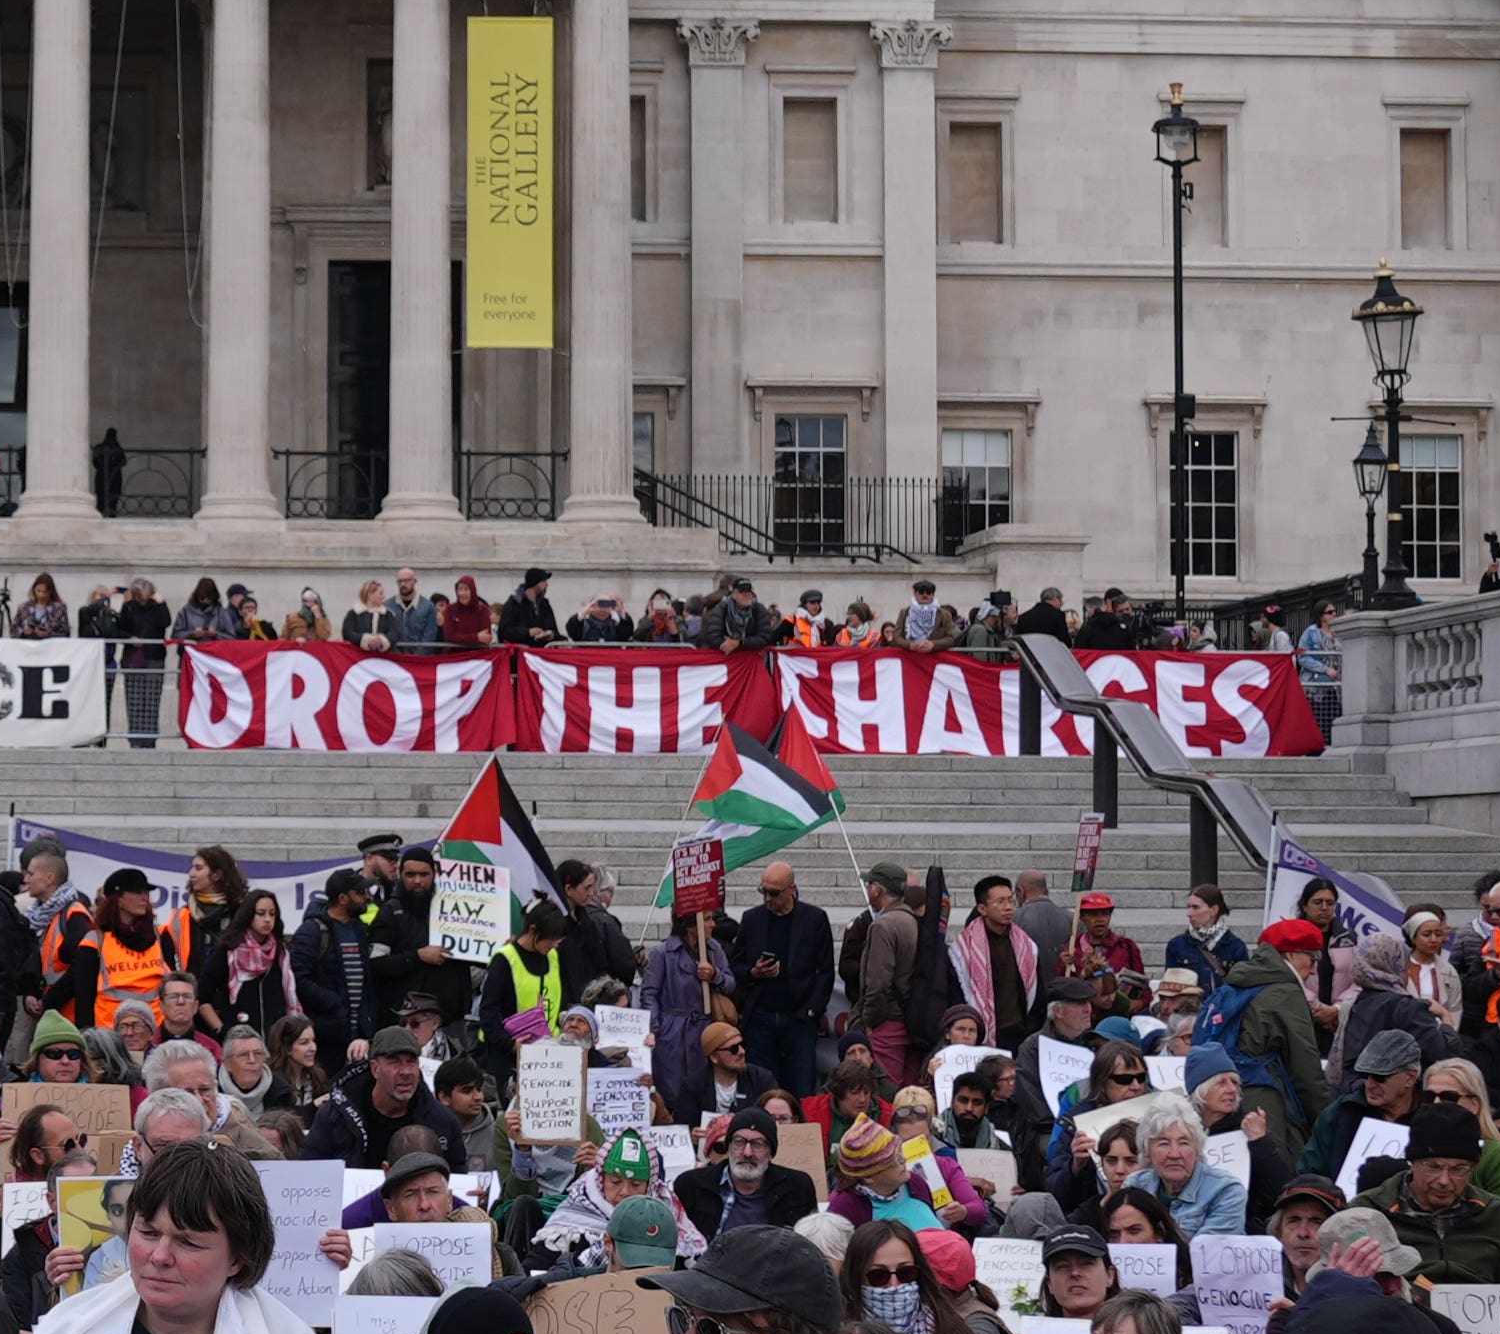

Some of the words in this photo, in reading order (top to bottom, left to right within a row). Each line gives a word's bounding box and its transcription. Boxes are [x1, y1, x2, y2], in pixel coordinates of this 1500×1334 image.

[490, 72, 510, 225] NATIONAL
[515, 73, 538, 226] GALLERY
[476, 155, 486, 186] THE
[483, 292, 508, 305] Free
[511, 292, 527, 305] for
[483, 309, 535, 322] everyone
[183, 646, 493, 753] DROP
[522, 652, 728, 757] THE
[435, 860, 496, 885] WHEN
[440, 900, 485, 917] LAW
[442, 935, 496, 957] DUTY
